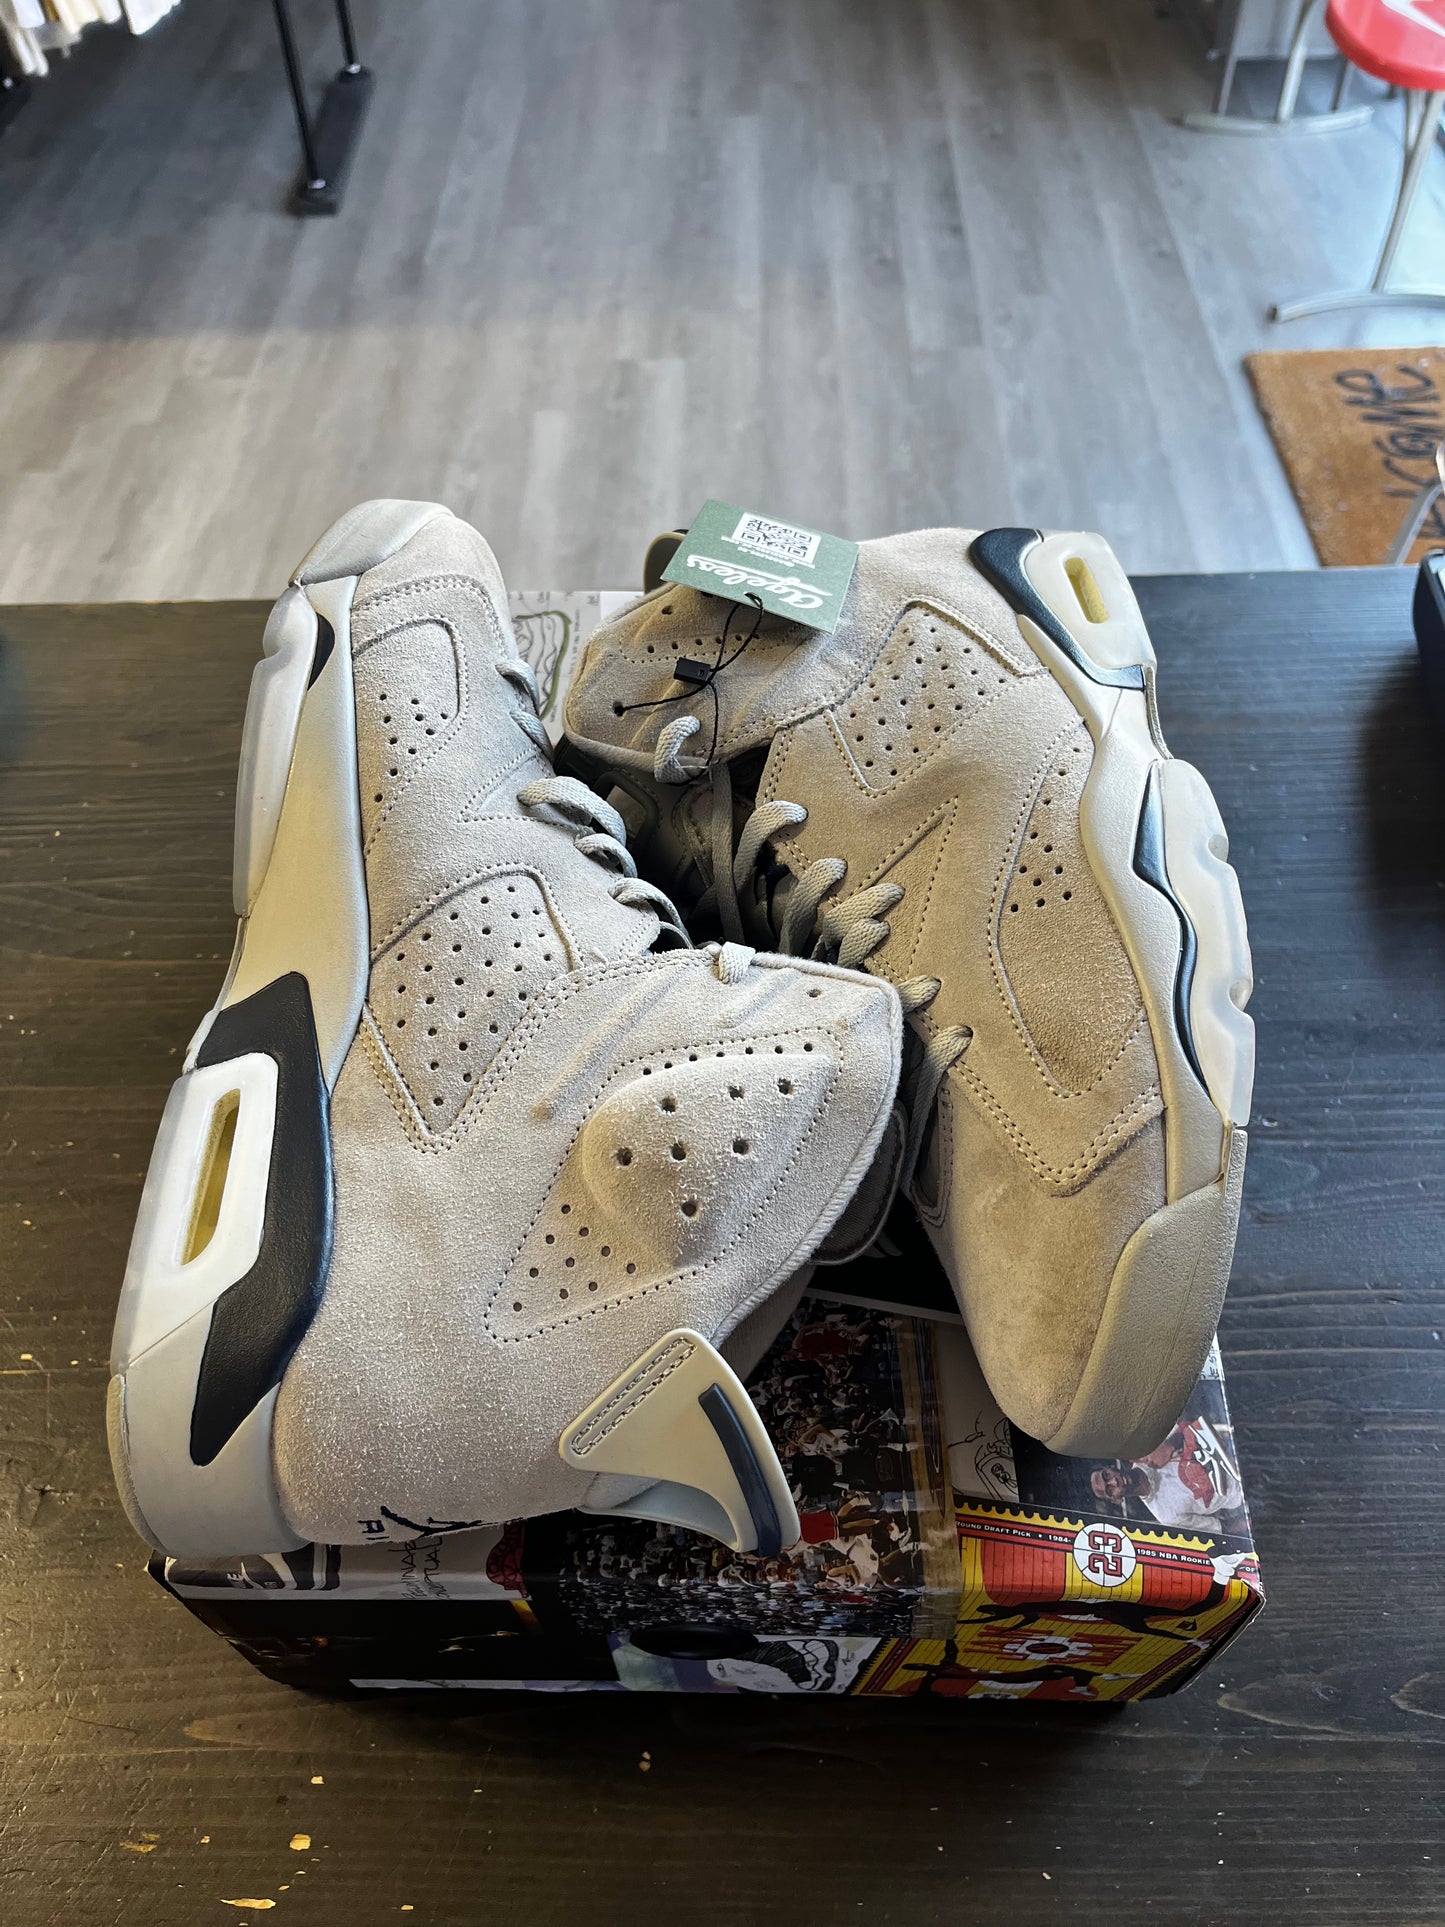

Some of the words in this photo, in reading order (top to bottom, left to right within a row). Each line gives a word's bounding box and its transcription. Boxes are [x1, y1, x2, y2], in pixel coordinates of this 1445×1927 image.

[687, 555, 827, 609] Ageless
[1088, 1530, 1123, 1578] 23
[1137, 1547, 1157, 1558] 1985
[1159, 1551, 1178, 1561] NBA
[1180, 1554, 1211, 1566] ROOKIE
